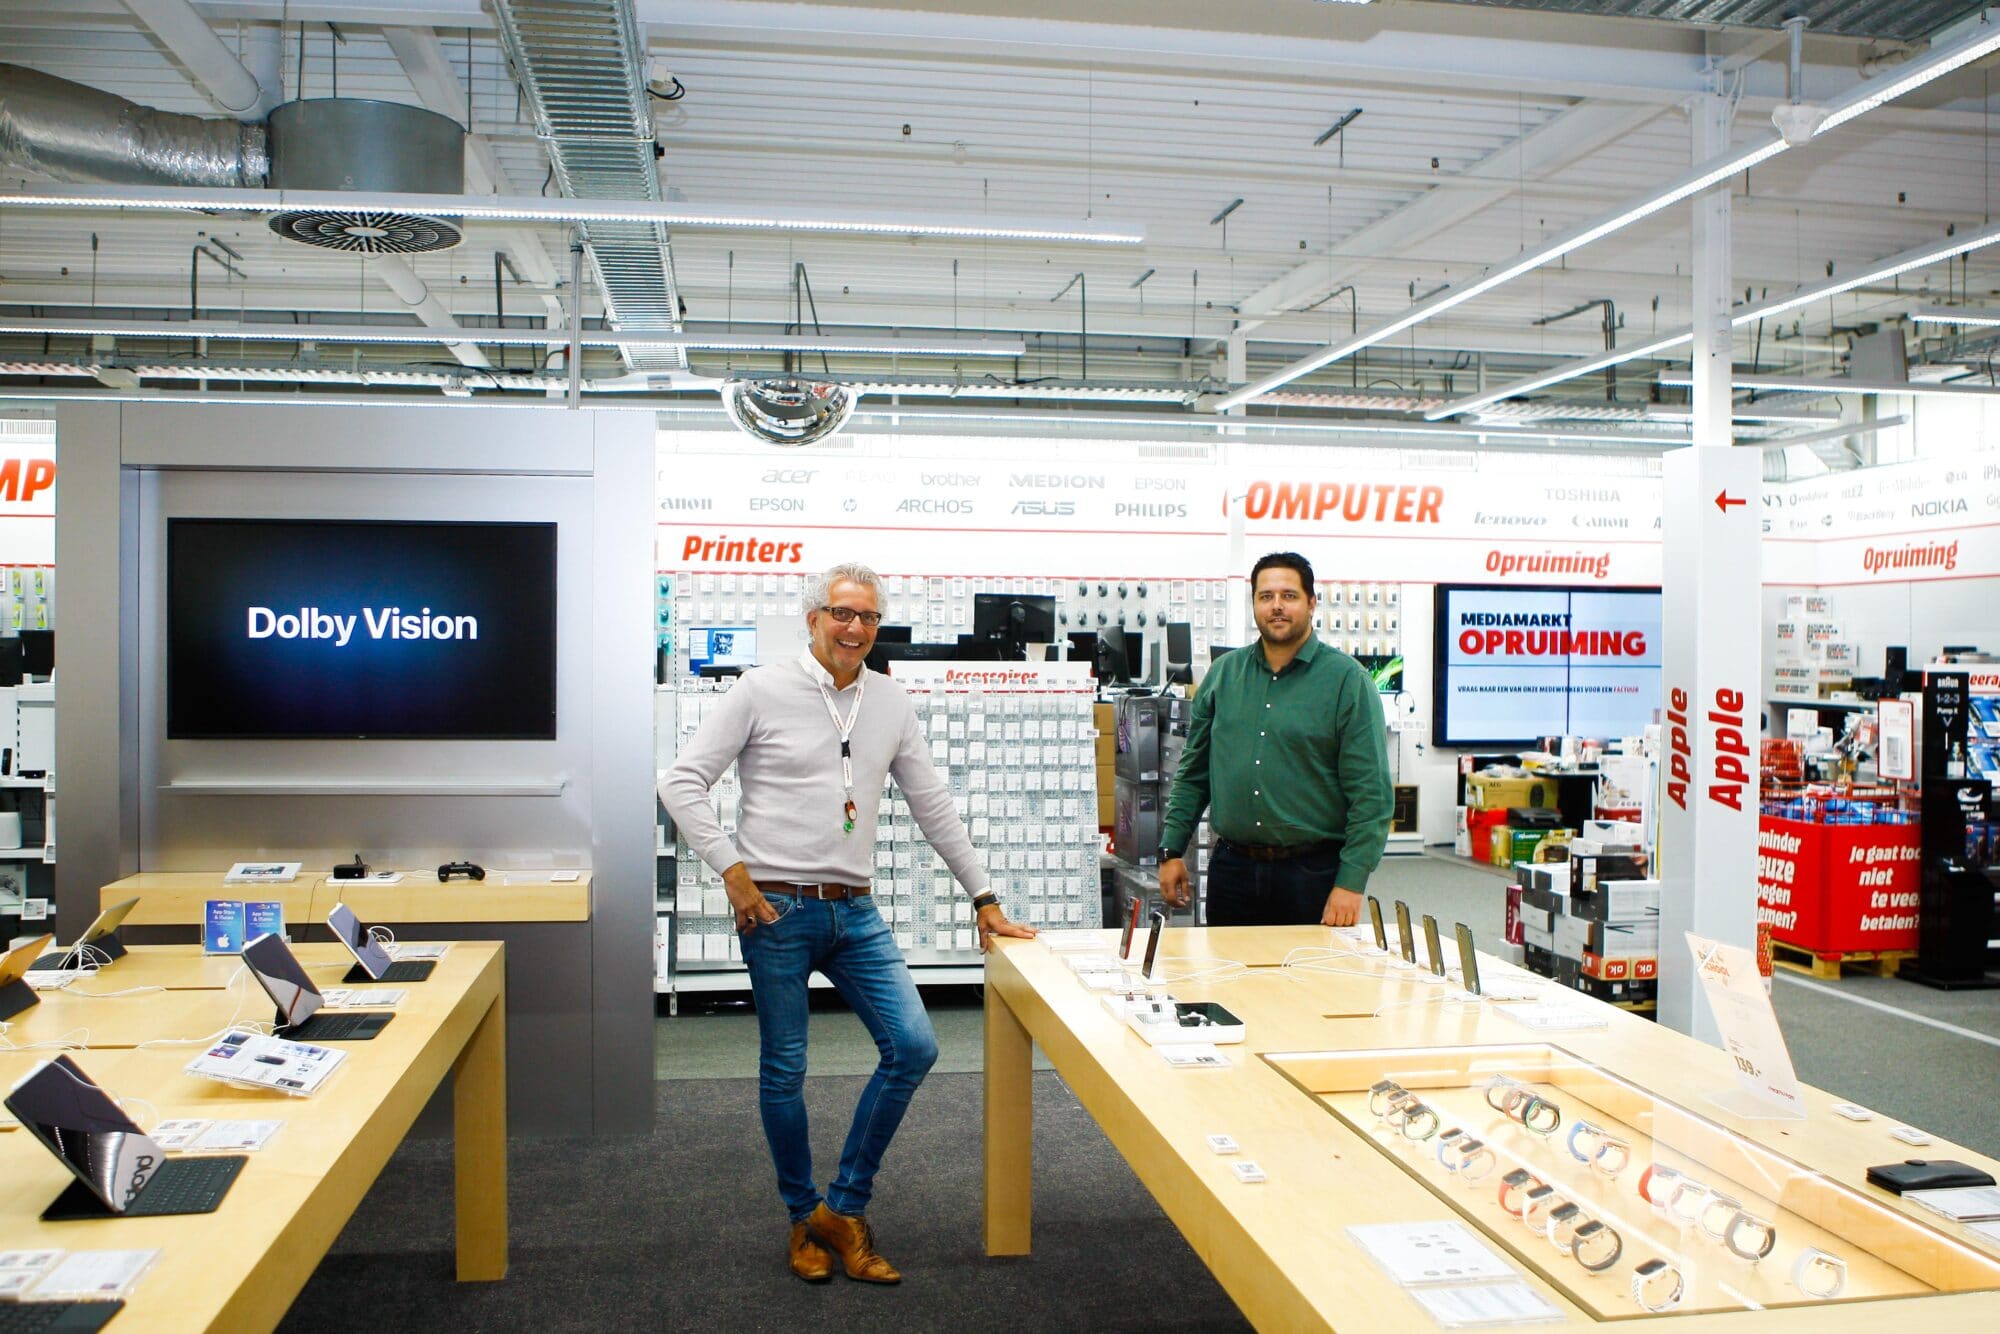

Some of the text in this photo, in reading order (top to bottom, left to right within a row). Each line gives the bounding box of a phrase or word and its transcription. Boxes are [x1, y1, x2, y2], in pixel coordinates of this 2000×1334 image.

[762, 469, 820, 485] acer
[921, 471, 982, 488] brother
[1009, 473, 1105, 489] MEDION
[1135, 477, 1187, 491] EPSON
[1222, 480, 1444, 524] OMPUTER
[1545, 487, 1621, 503] TOSHIBA
[750, 498, 804, 511] EPSON
[896, 498, 973, 513] ARCHOS
[1011, 501, 1076, 516] ASUS
[1115, 502, 1188, 519] PHILIPS
[1912, 498, 1969, 518] NOKIA
[1474, 511, 1548, 526] lenovo
[682, 534, 803, 564] Printers
[1863, 540, 1959, 575] Opruiming
[1486, 550, 1610, 579] Opruiming
[248, 606, 478, 647] Dolby Vision
[1461, 612, 1572, 628] MEDIAMARKT
[1458, 629, 1646, 656] OPRUIMING
[946, 668, 1038, 686] Accessoires
[1480, 685, 1496, 694] NAAR
[1498, 685, 1508, 694] EEN
[1510, 685, 1521, 694] VAN
[1585, 685, 1600, 694] VOOR
[1667, 687, 1690, 811] Apple
[1708, 688, 1750, 812] Apple
[1759, 829, 1801, 854] minder
[1849, 846, 1864, 864] Je
[1865, 845, 1898, 865] gaat
[1859, 867, 1893, 886] niet
[1871, 891, 1920, 908] te vee
[1859, 914, 1920, 931] betalen?
